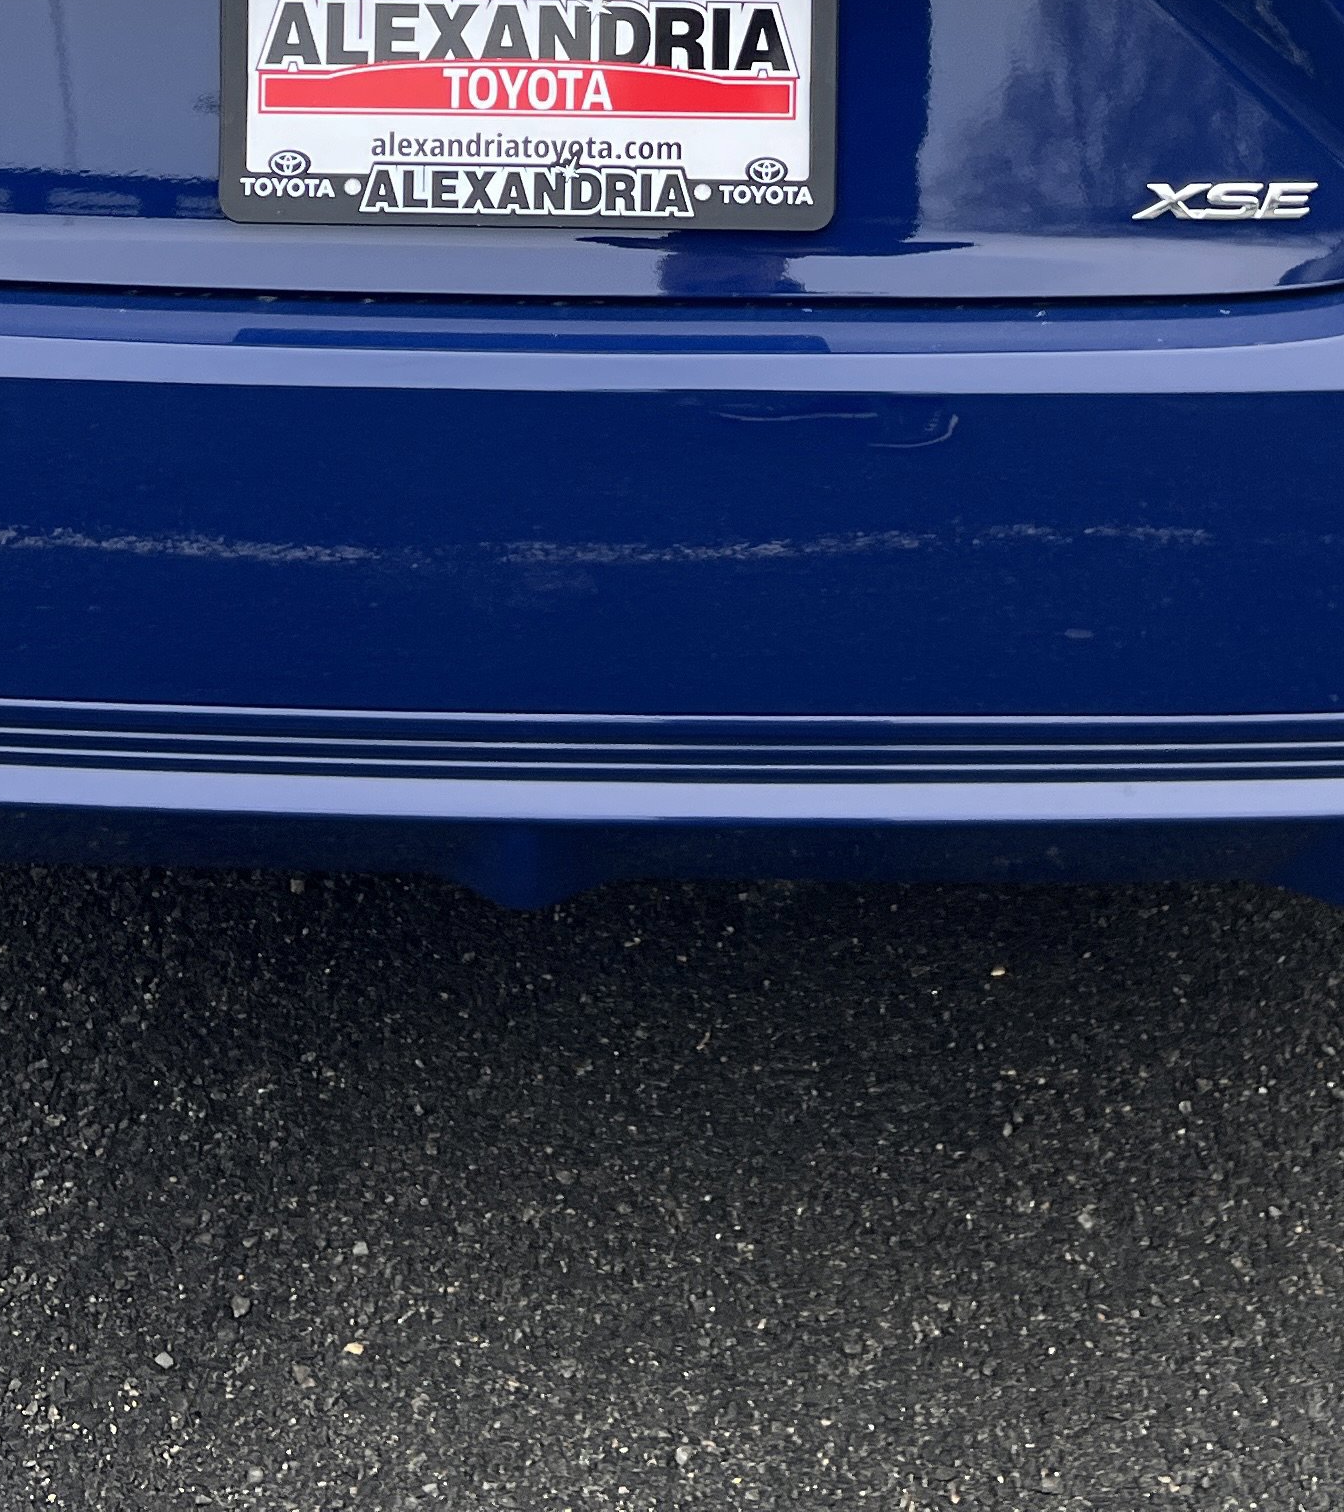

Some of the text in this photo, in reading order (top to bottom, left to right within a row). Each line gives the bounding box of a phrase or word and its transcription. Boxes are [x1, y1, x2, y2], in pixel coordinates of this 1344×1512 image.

[442, 67, 614, 112] TOYOTA
[370, 130, 683, 168] alexandriatoyota.com
[239, 176, 336, 199] TOYOTA
[362, 166, 692, 215] ALEXANDRIA
[718, 184, 814, 206] TOYOTA
[1131, 182, 1320, 220] XSE
